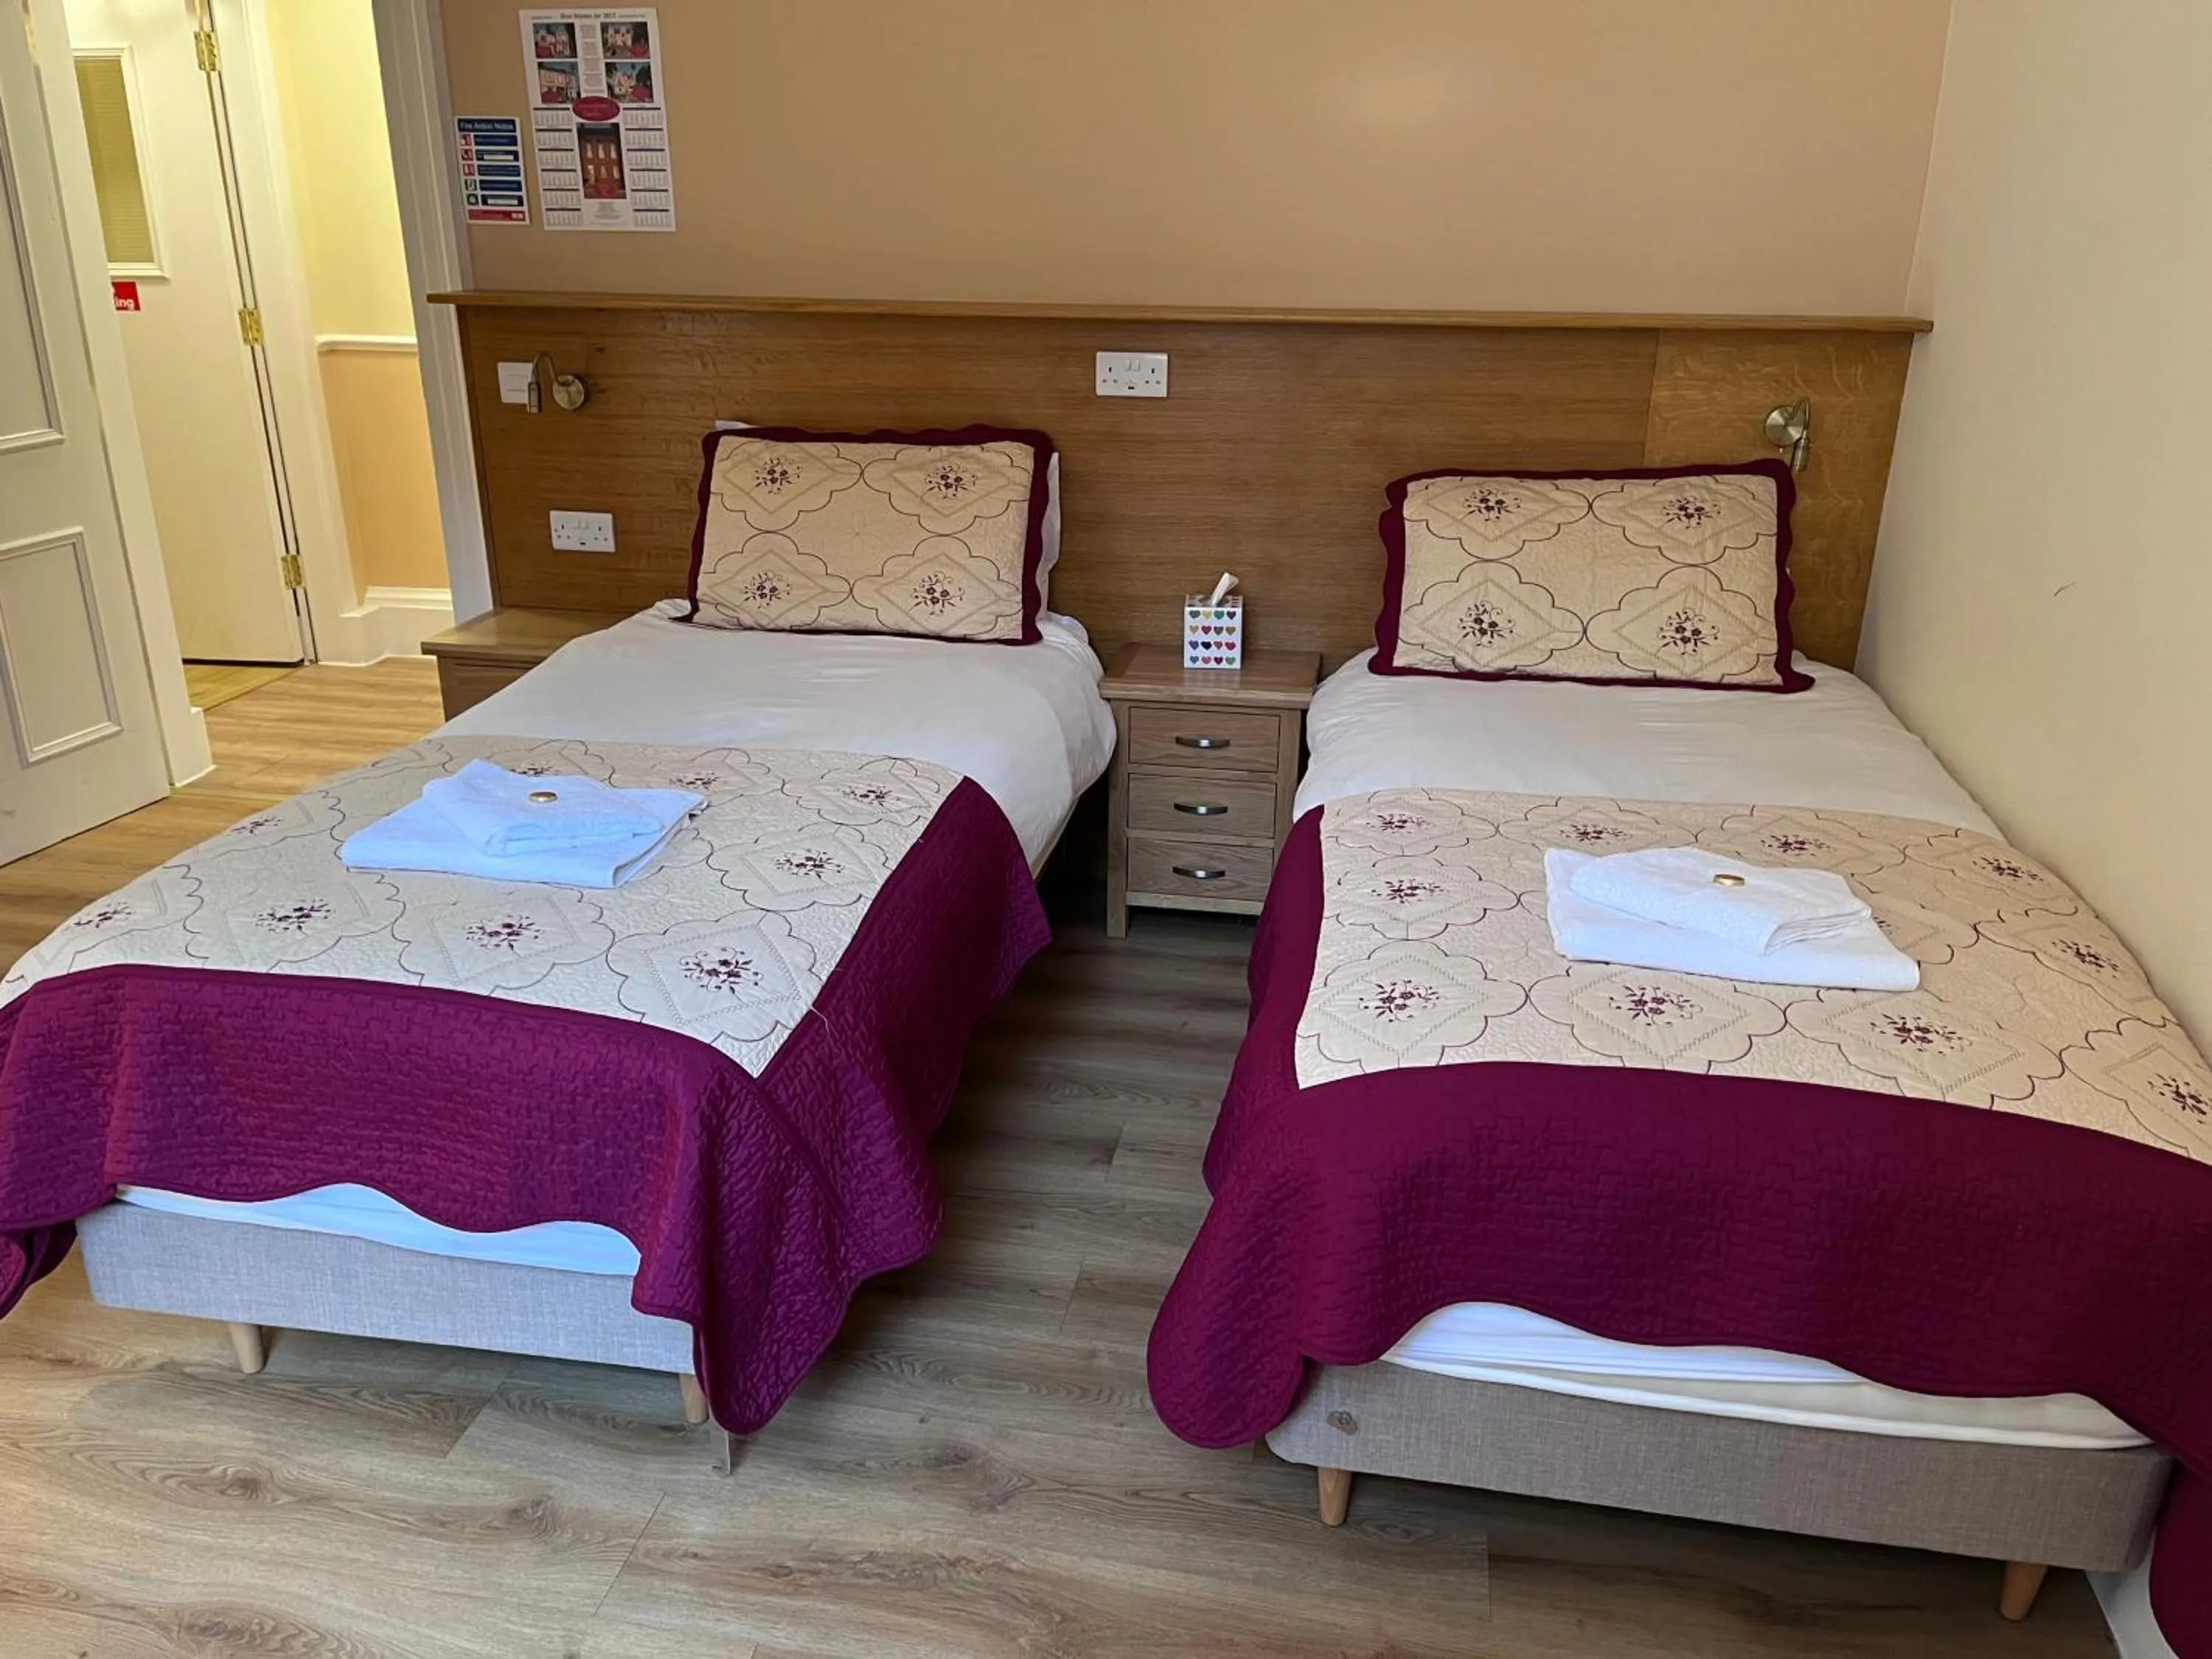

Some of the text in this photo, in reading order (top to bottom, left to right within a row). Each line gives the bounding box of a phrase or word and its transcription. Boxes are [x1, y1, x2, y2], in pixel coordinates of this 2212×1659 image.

[460, 122, 513, 130] Fire Action Notice
